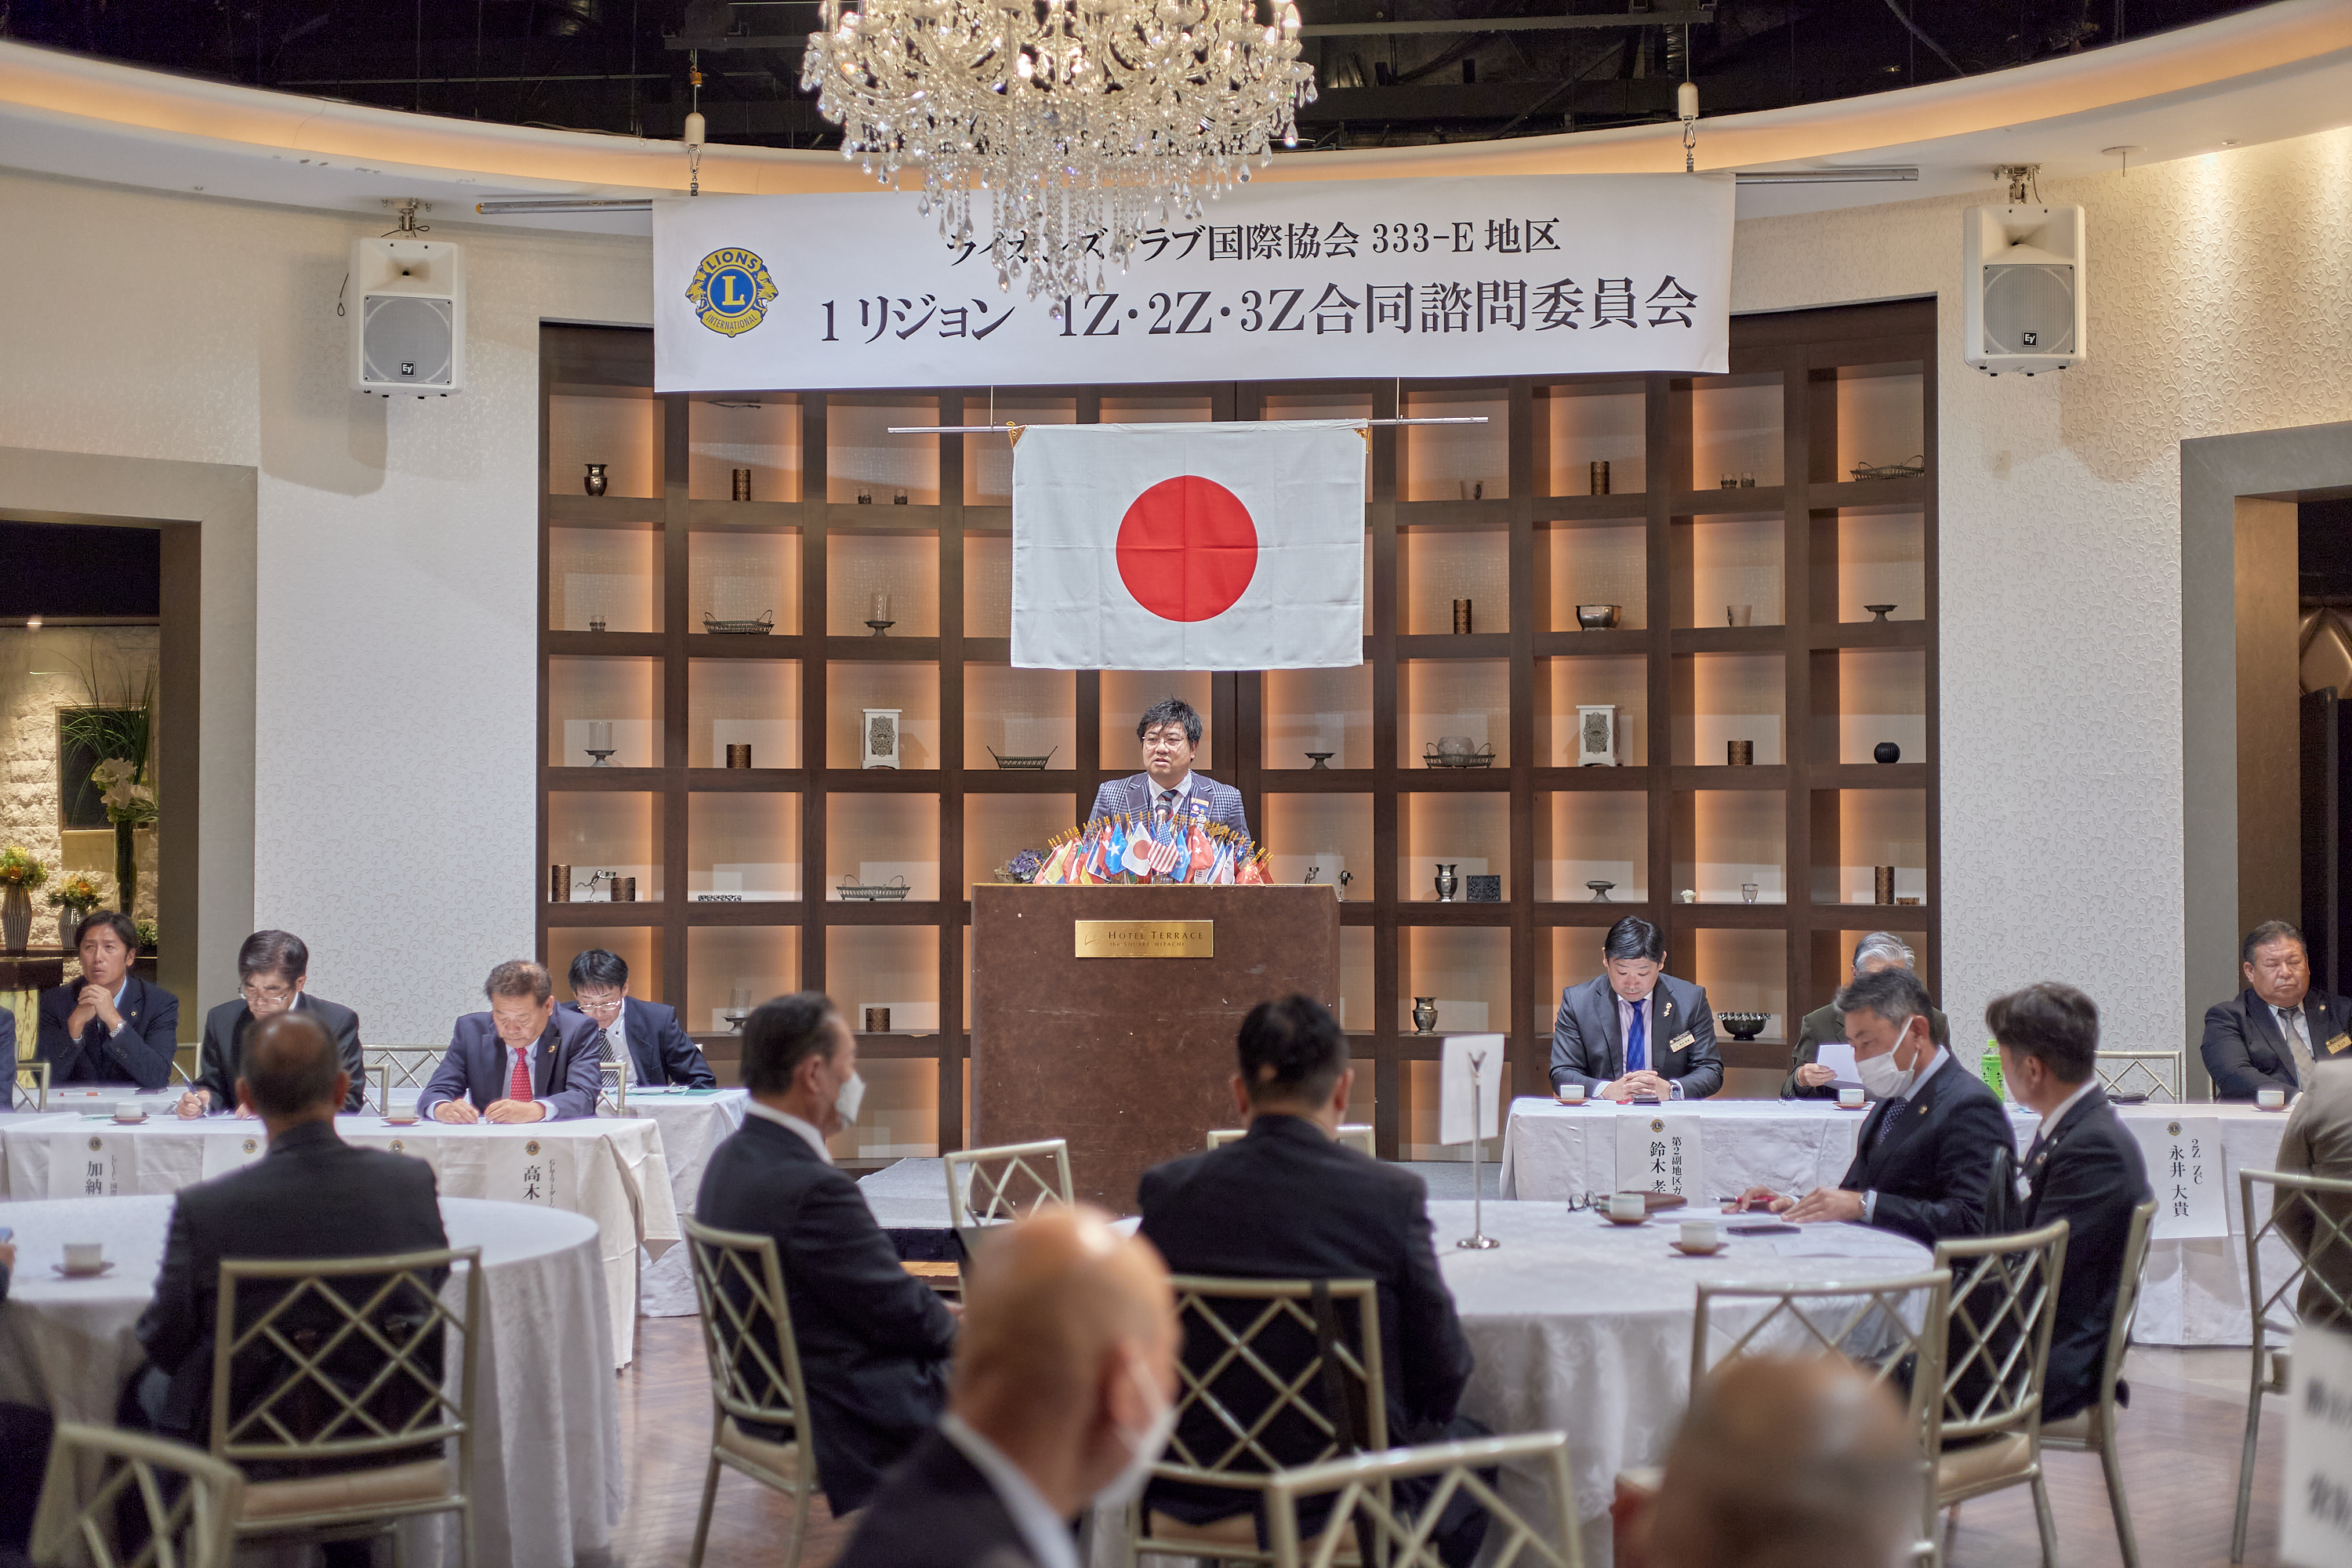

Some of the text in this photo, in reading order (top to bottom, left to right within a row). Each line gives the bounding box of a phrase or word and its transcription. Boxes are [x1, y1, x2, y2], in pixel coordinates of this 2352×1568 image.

[1372, 221, 1474, 253] 333-E
[1484, 216, 1562, 254] 地区
[706, 251, 758, 270] LIONS
[722, 276, 746, 306] L
[706, 314, 758, 330] INTERNATIONAL
[1151, 931, 1203, 939] TERRACE
[1650, 1142, 1666, 1174] 鈴木
[1671, 1136, 1682, 1197] 第2副地区ガ
[85, 1160, 103, 1195] 加納
[523, 1165, 541, 1200] 高木
[2169, 1145, 2189, 1217] 永井 大貴
